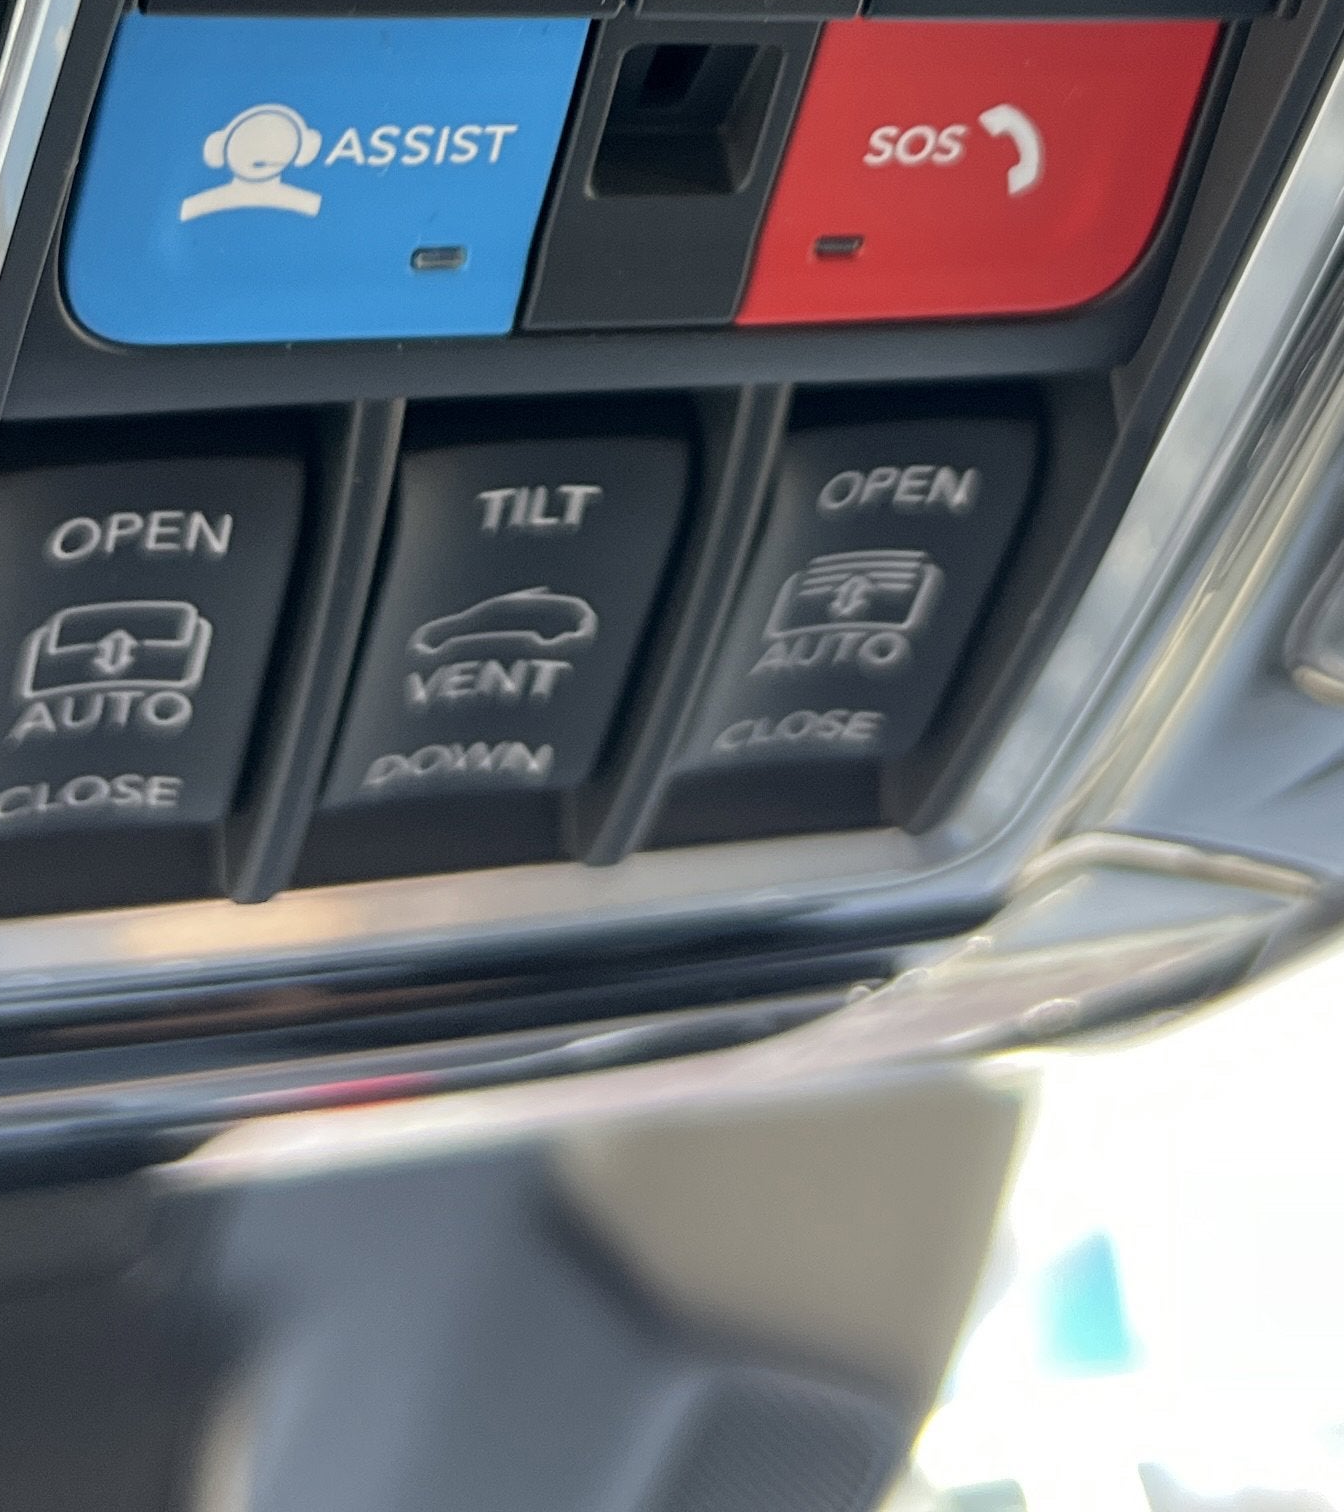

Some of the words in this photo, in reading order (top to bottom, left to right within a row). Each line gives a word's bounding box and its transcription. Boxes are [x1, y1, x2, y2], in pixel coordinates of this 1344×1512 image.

[324, 124, 518, 165] ASSIST
[863, 124, 967, 165] SOS
[478, 484, 602, 531] TILT
[817, 464, 980, 513] OPEN
[51, 510, 232, 562] OPEN
[748, 630, 910, 676] AUTO
[405, 660, 573, 704] VENT
[6, 691, 193, 742] AUTO
[711, 708, 886, 754] CLOSE
[360, 741, 555, 791] DOWN
